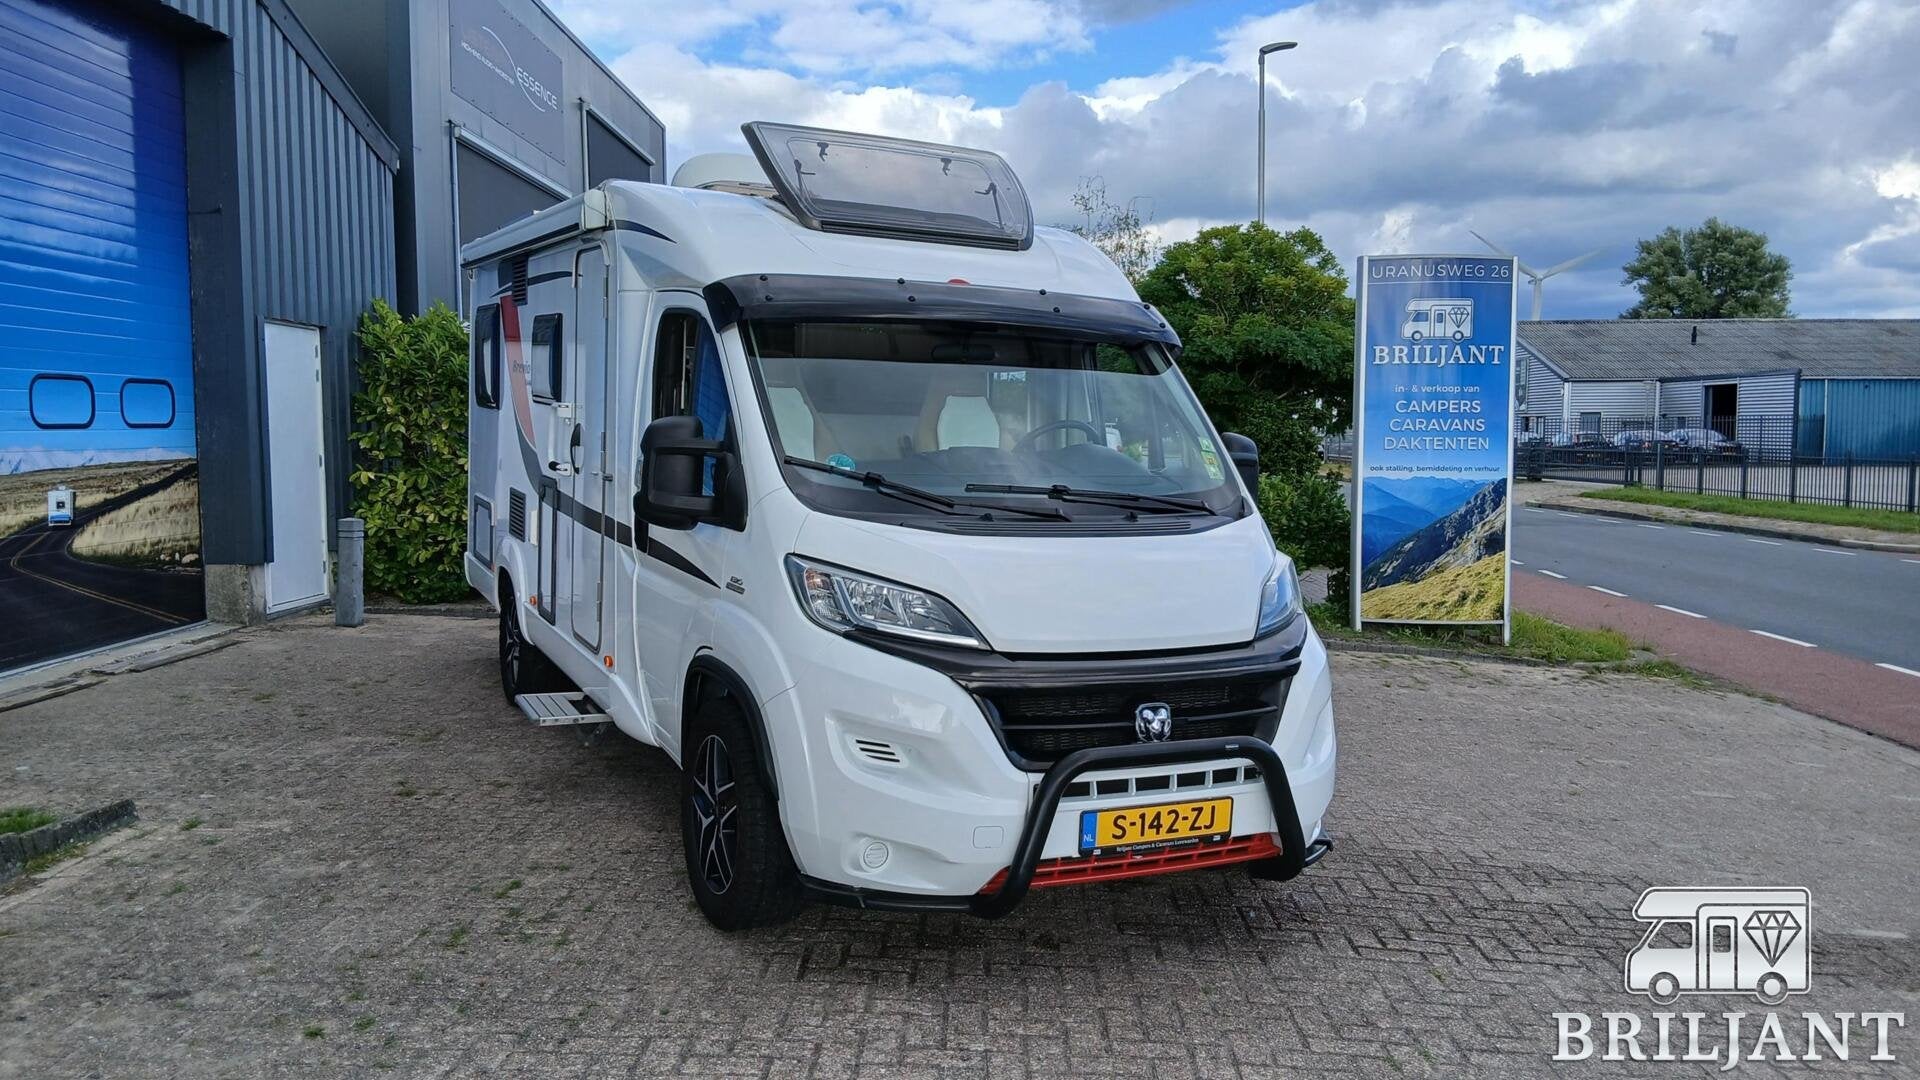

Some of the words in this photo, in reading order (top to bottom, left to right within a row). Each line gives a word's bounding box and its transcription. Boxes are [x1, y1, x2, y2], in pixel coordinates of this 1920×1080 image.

[516, 67, 558, 110] ESSENCE
[1372, 264, 1485, 279] URANUSWEG
[1491, 265, 1510, 278] 26
[1372, 345, 1505, 368] BRILJANT
[1394, 384, 1408, 392] in-
[1411, 384, 1418, 392] &
[1421, 384, 1461, 394] verkoop
[1395, 400, 1481, 413] CAMPERS
[1389, 418, 1486, 432] CARAVANS
[1384, 437, 1489, 450] DAKTENTEN
[1385, 465, 1414, 473] stalling,
[1416, 465, 1462, 473] bemiddeling
[1111, 805, 1216, 840] S-142-ZJ
[1083, 834, 1094, 842] NL
